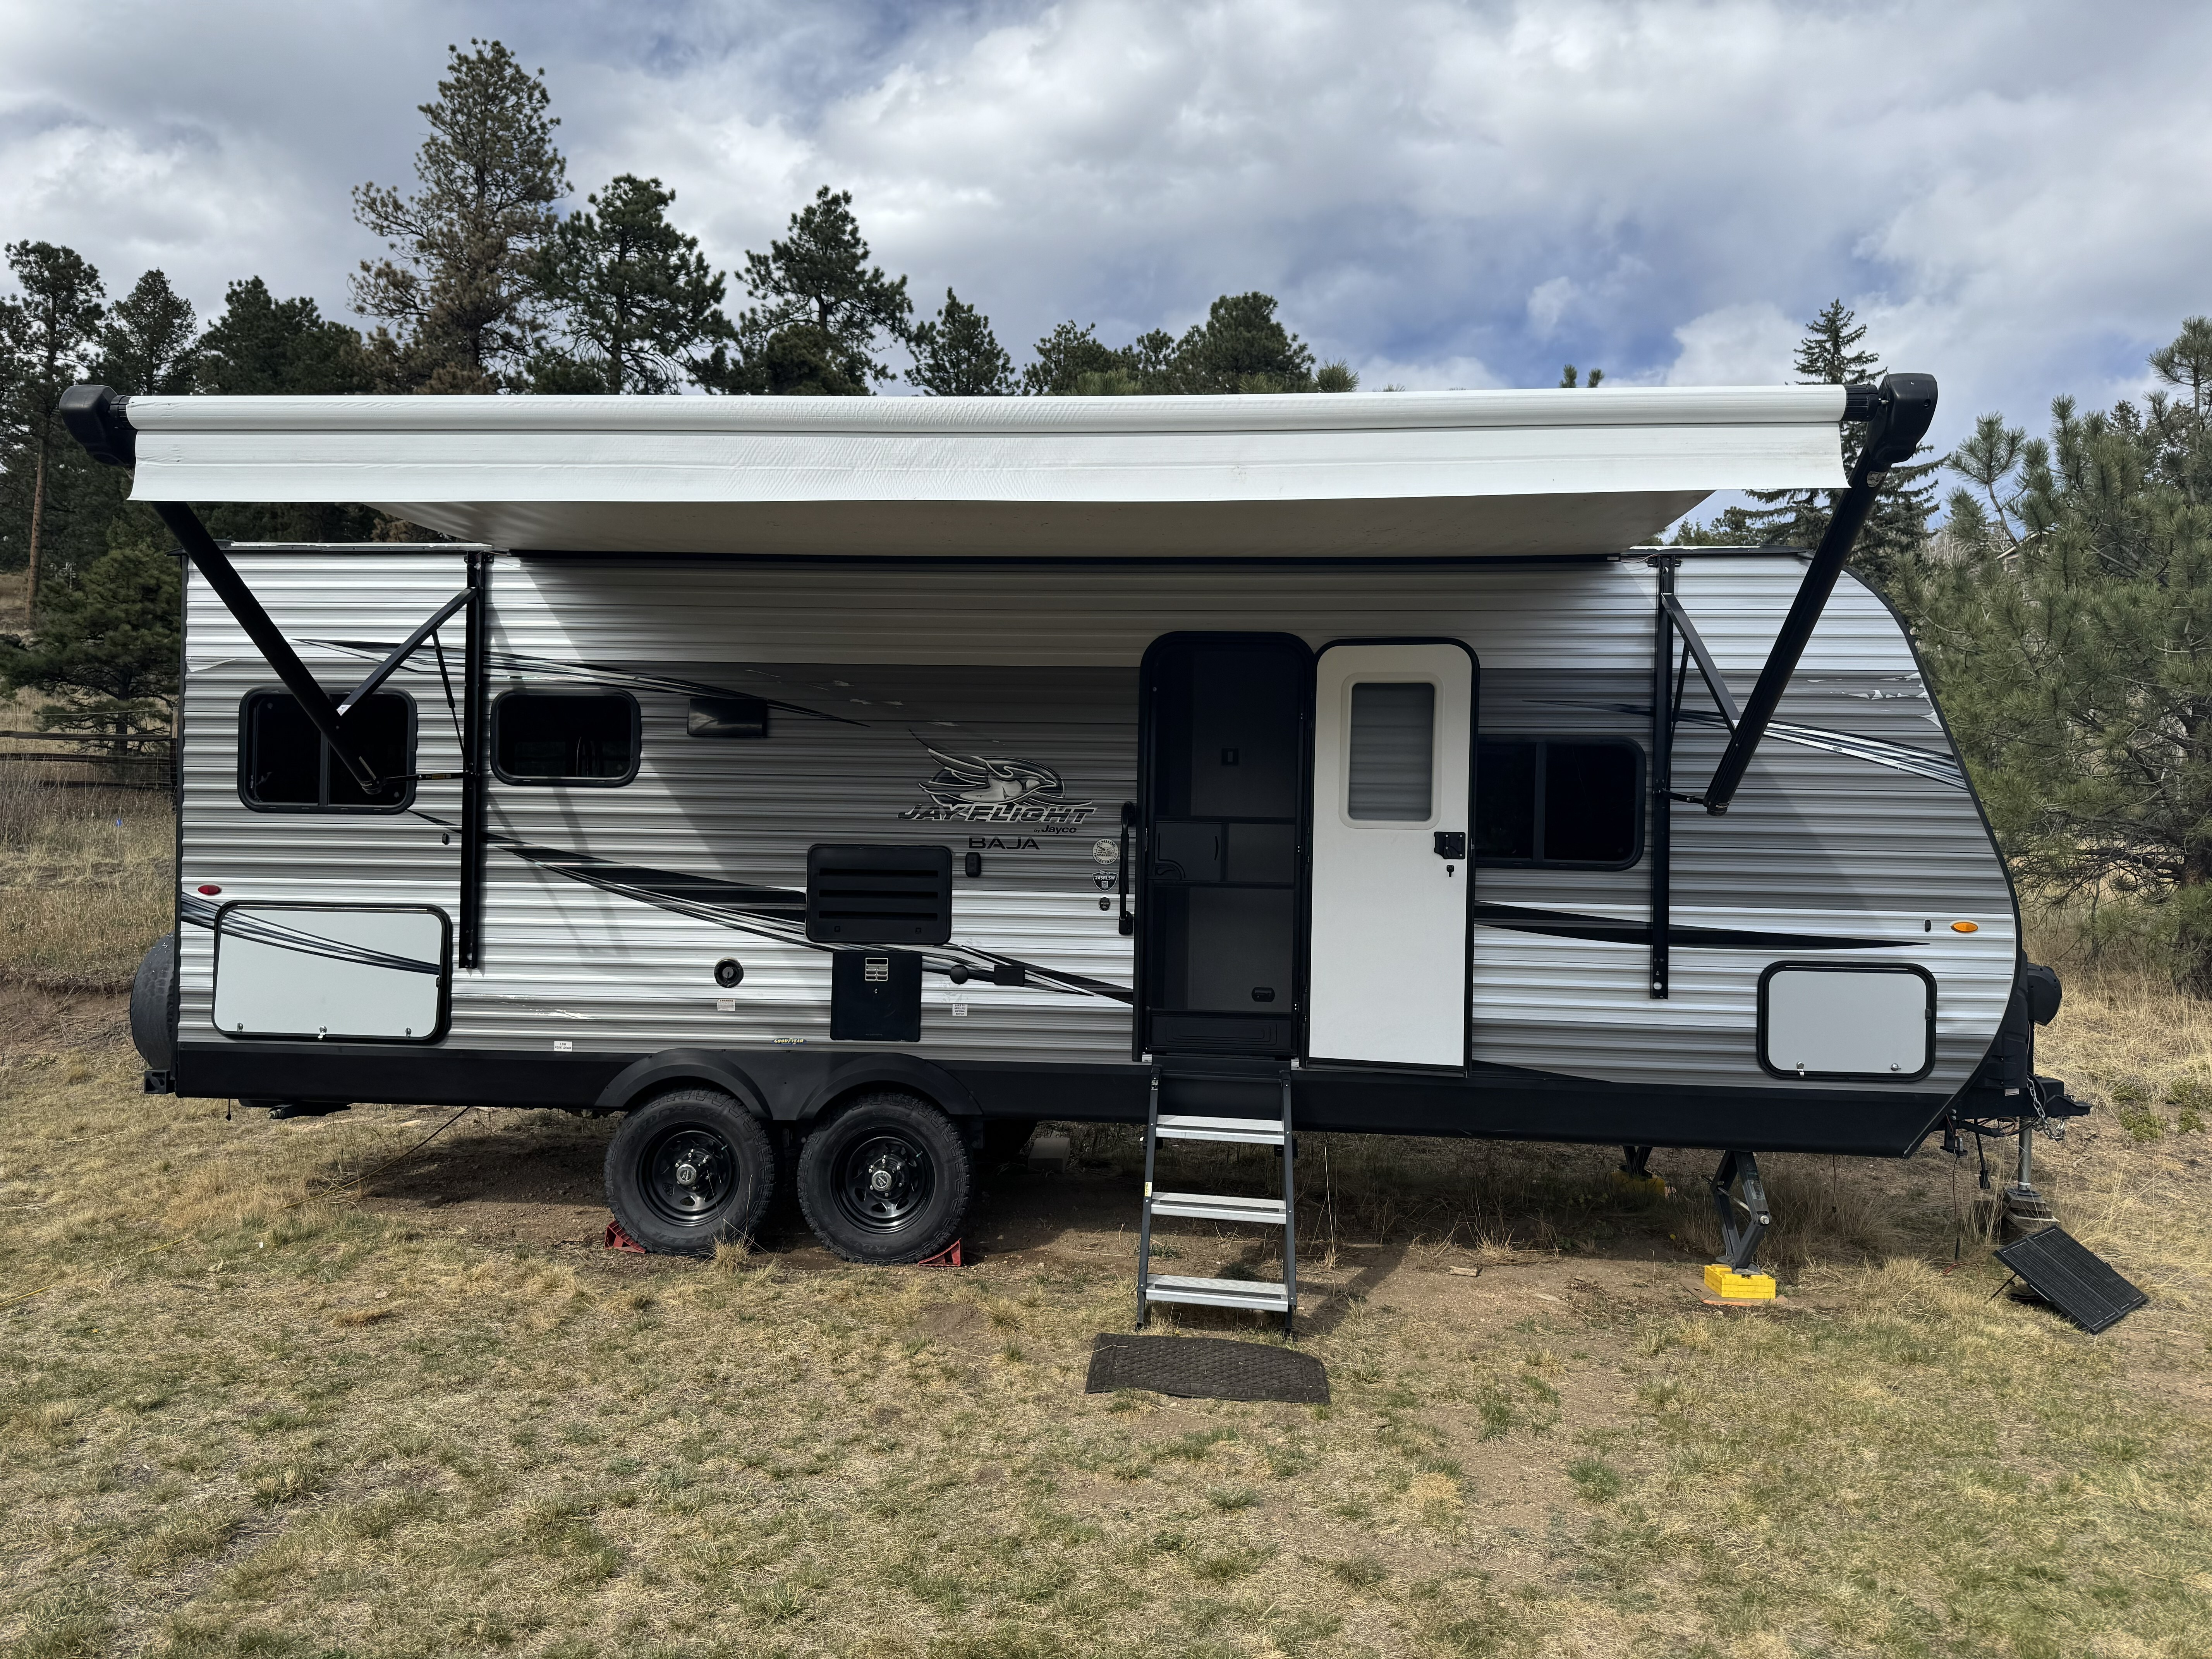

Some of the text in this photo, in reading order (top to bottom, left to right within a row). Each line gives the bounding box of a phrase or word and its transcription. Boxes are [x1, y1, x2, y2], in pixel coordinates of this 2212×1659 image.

[964, 803, 1098, 824] FLIGHT
[1041, 825, 1077, 834] Jayco
[969, 836, 1040, 850] BAJA
